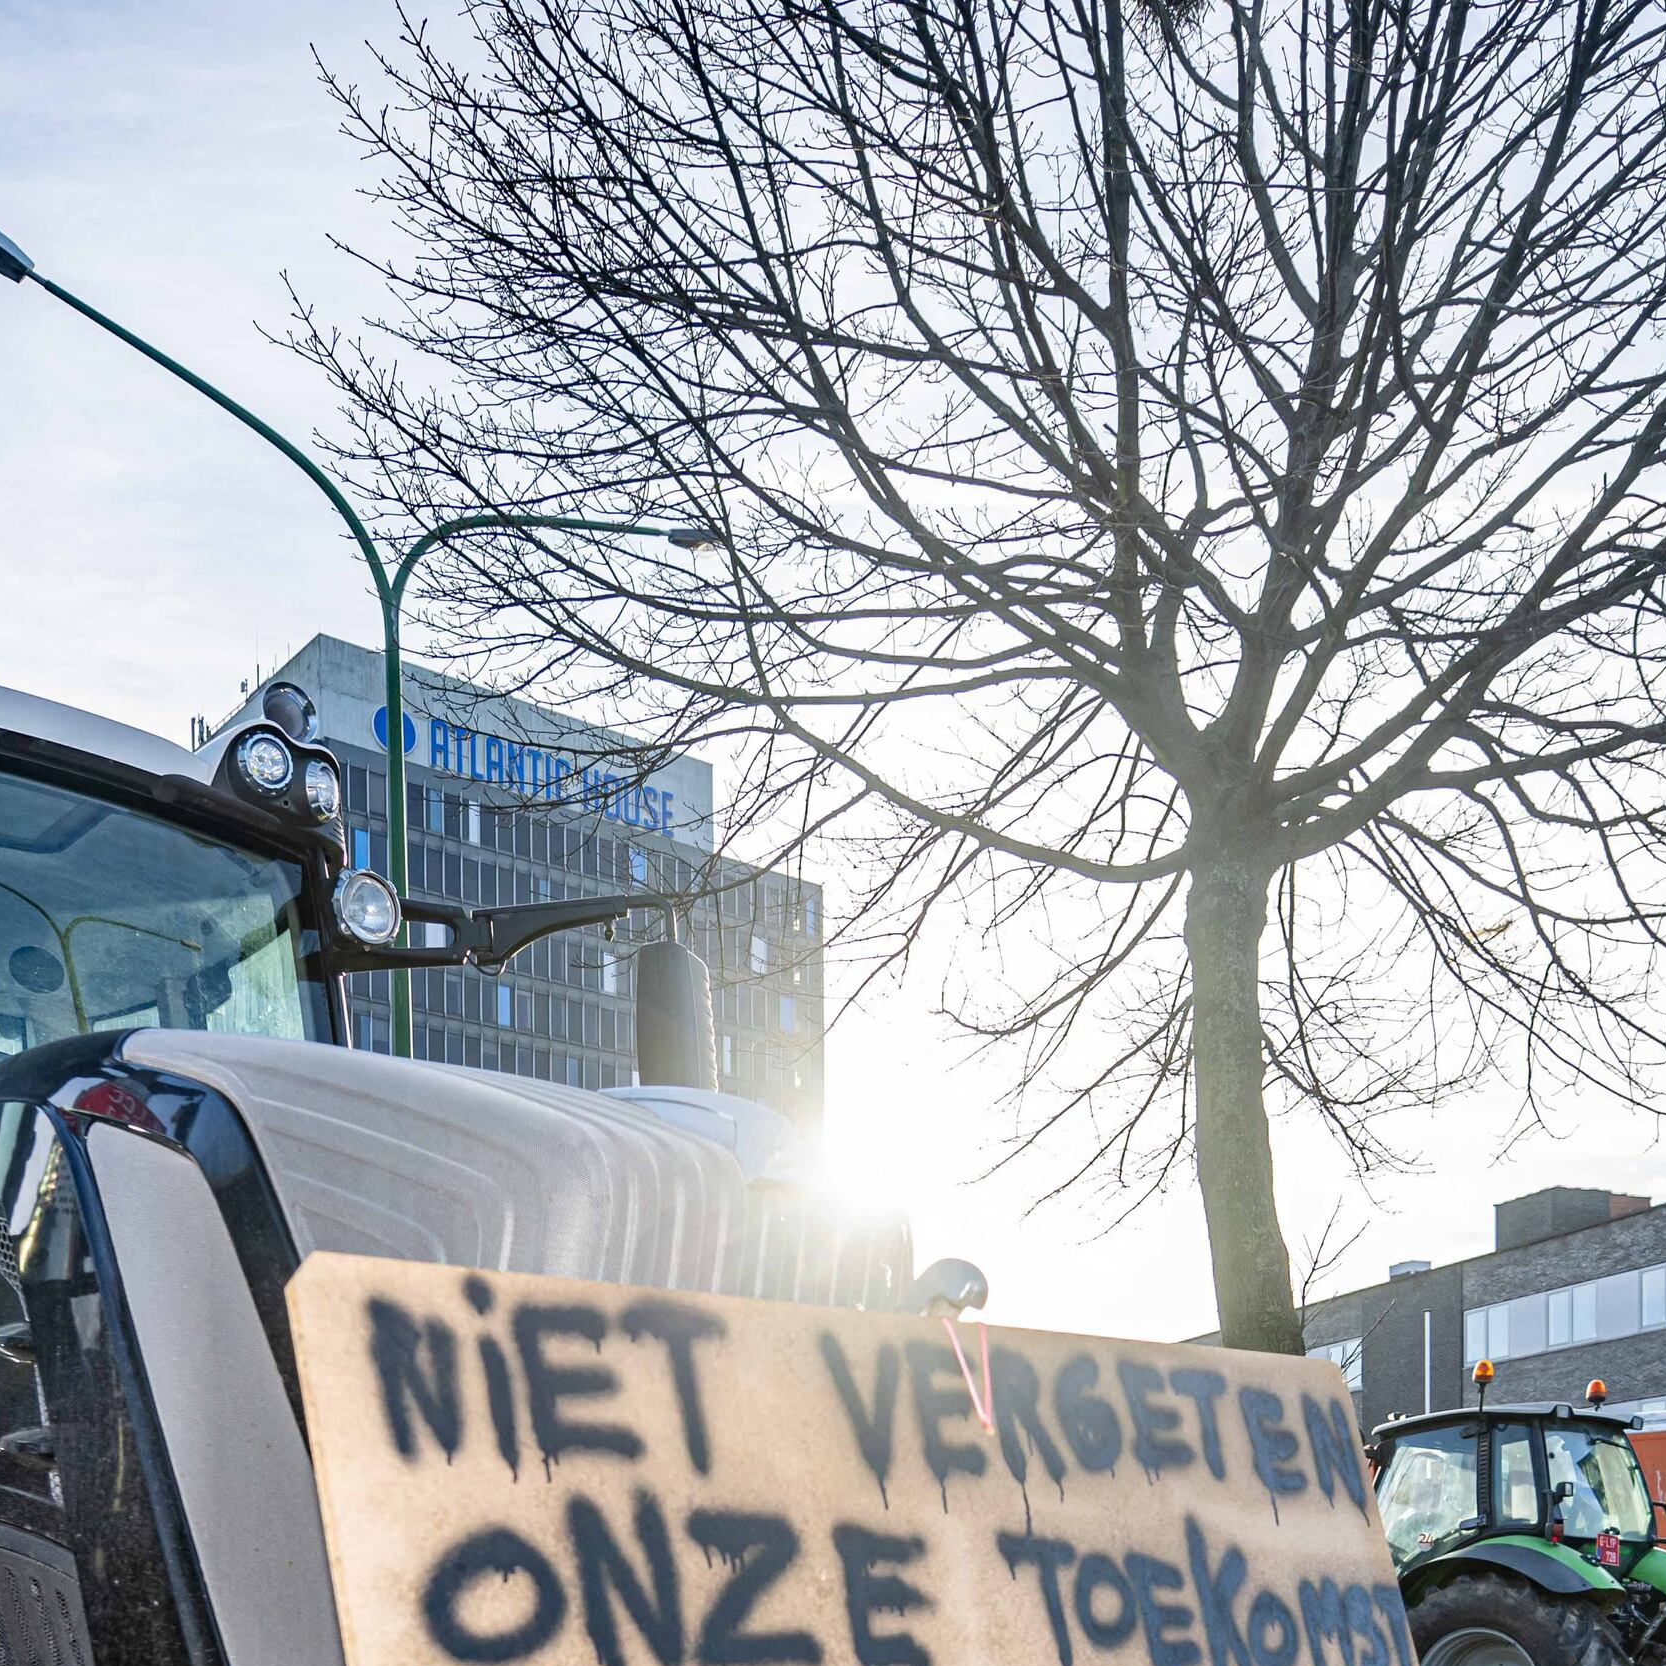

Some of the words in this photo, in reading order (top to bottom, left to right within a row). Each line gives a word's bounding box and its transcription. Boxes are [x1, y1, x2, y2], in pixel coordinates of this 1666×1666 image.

[430, 718, 570, 802] ATLANTIC
[582, 767, 675, 839] HOUSE
[819, 1325, 1369, 1526] VERGETEN
